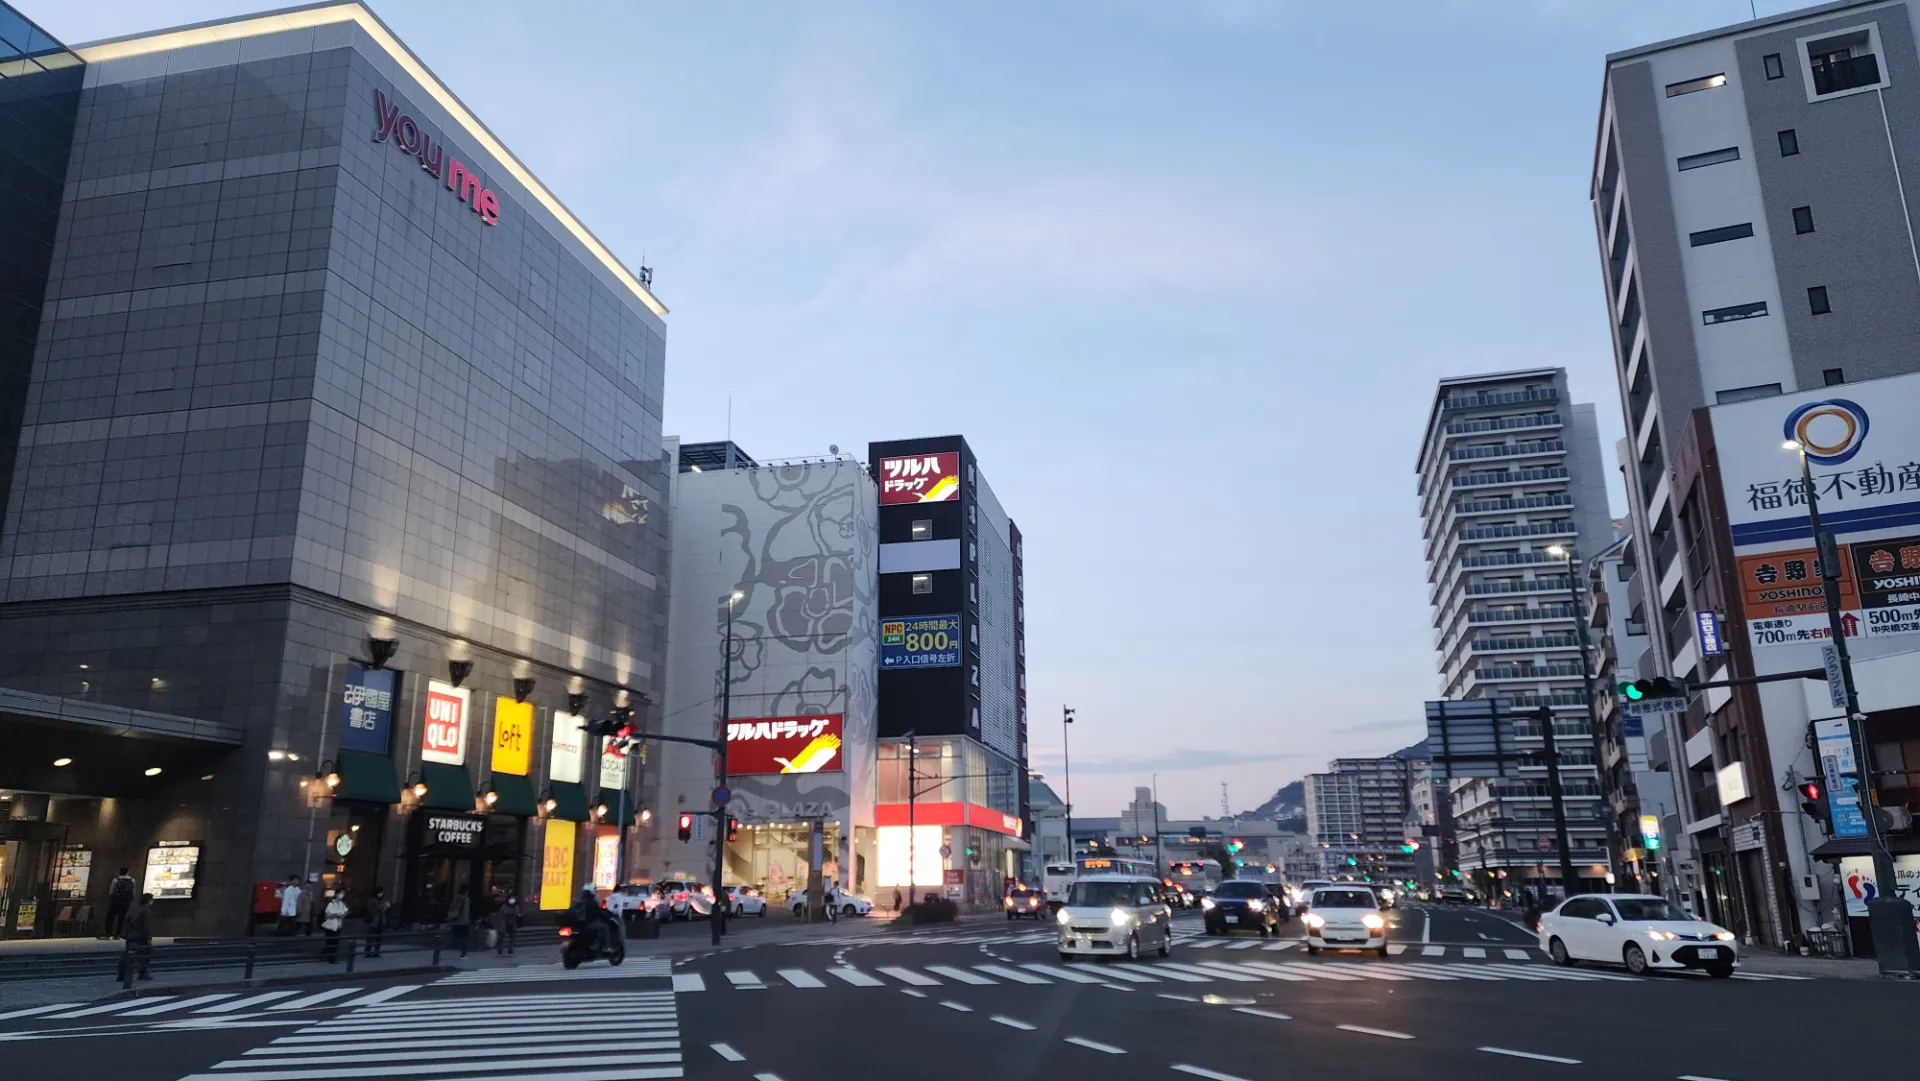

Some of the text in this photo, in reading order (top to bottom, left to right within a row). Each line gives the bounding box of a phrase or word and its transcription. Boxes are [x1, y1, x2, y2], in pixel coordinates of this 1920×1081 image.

[375, 88, 499, 226] you me
[884, 457, 941, 478] ツルハ
[884, 477, 928, 493] ドラッグ
[1746, 461, 1920, 511] 福徳不動産
[1873, 576, 1920, 590] YOSHI
[1759, 586, 1826, 600] YOSHINO
[884, 624, 903, 635] NPC
[905, 619, 958, 632] 24時間最大
[1752, 619, 1793, 630] 電車通り
[430, 698, 459, 723] UNI
[349, 707, 377, 730] 書店
[427, 723, 457, 748] QLO
[428, 817, 483, 832] STARBUCKS
[438, 831, 472, 844] COFFEE
